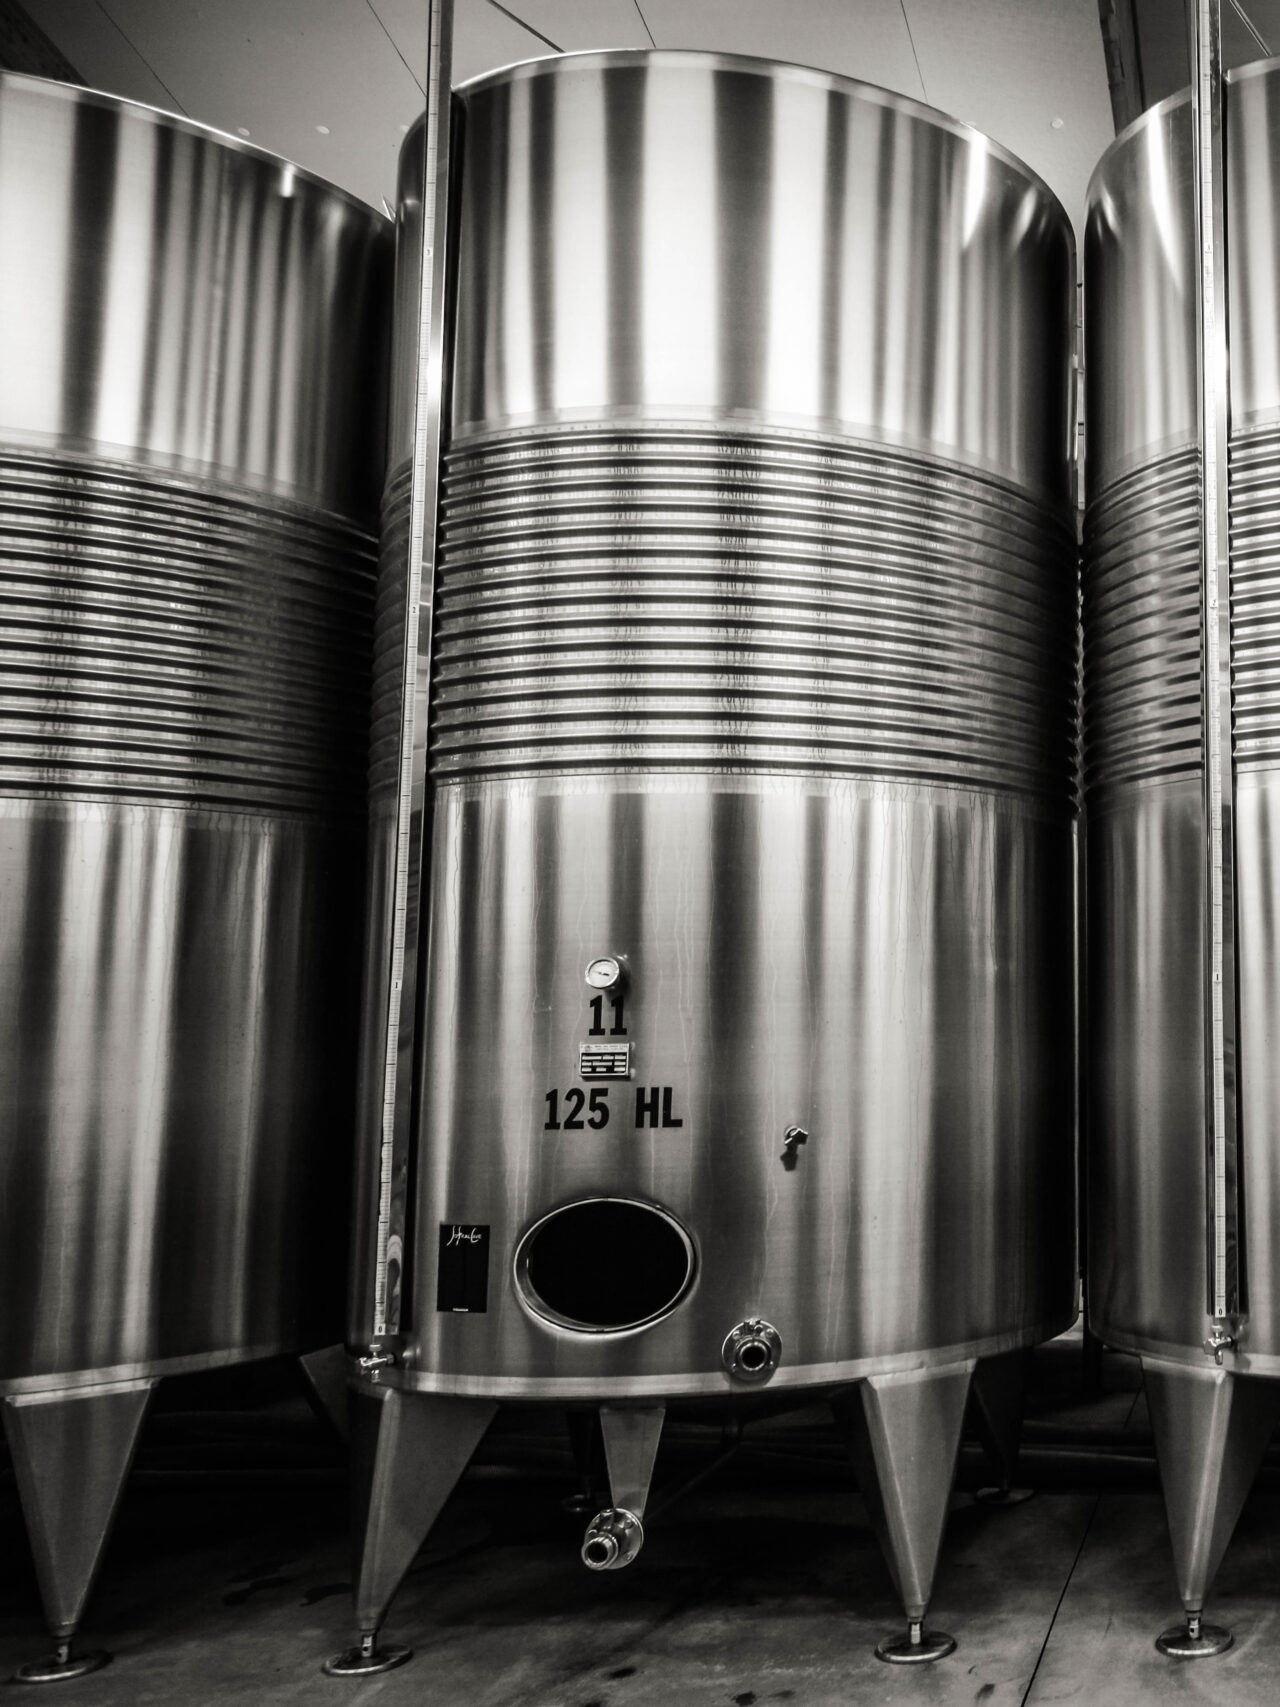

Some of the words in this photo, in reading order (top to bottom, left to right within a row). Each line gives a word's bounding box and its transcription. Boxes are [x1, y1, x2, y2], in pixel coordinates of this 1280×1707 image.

[588, 995, 628, 1036] 11
[544, 1088, 610, 1130] 125
[635, 1087, 683, 1128] HL
